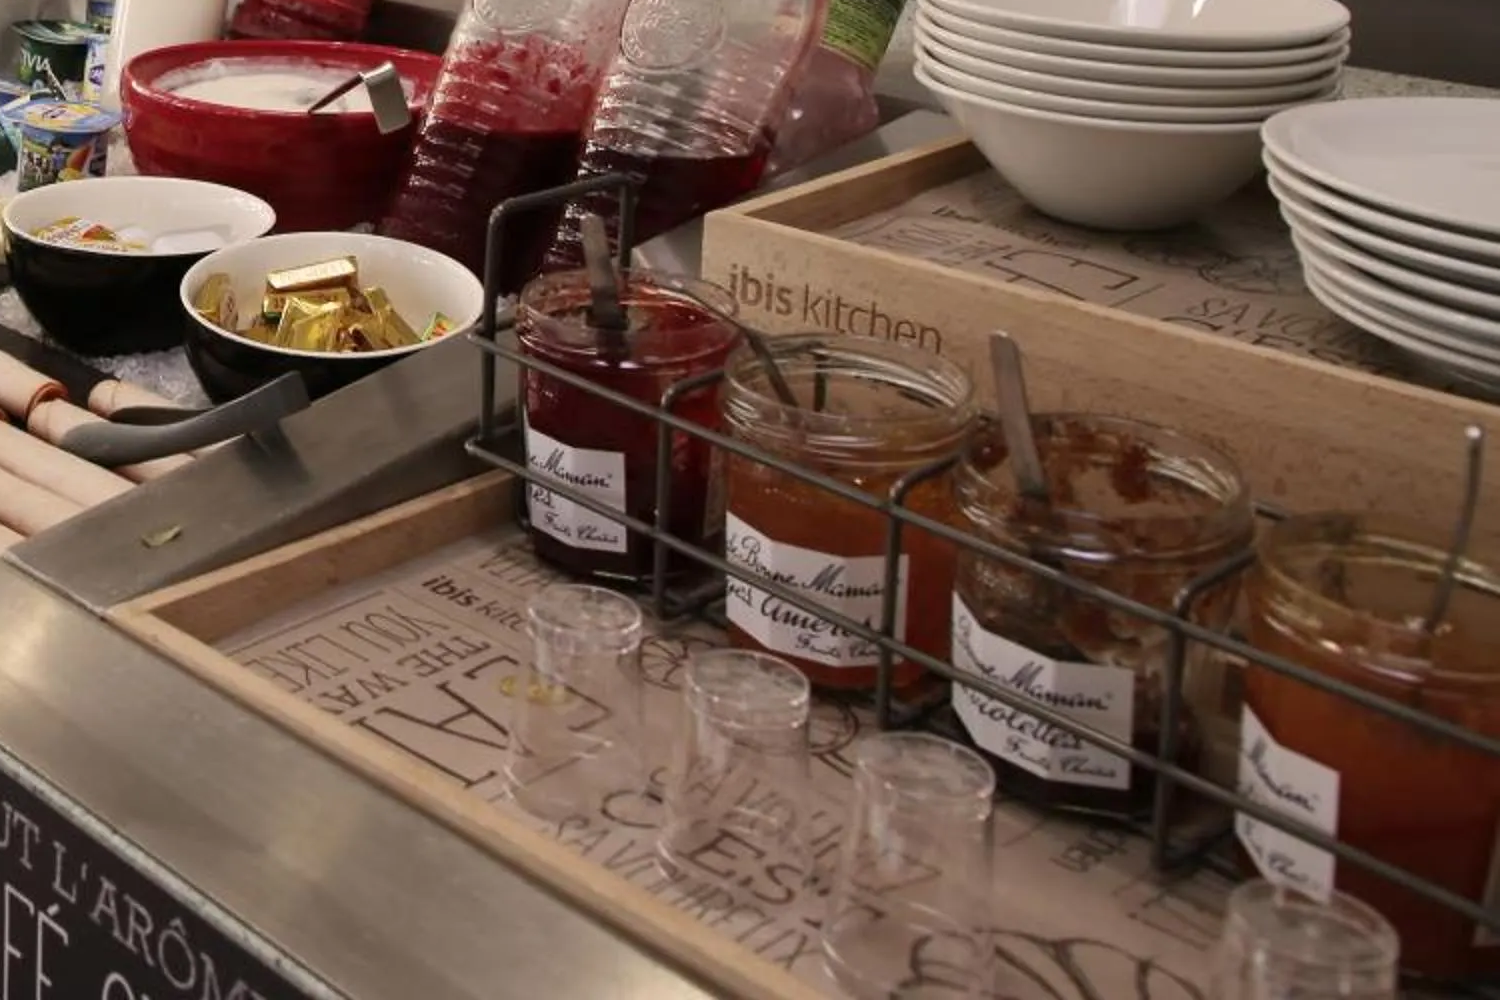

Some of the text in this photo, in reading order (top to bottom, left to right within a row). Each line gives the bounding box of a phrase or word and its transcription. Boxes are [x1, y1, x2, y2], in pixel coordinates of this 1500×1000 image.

[729, 263, 942, 355] ibis kitchen
[421, 575, 480, 607] ibis
[802, 563, 884, 598] Mama
[339, 604, 450, 653] YOU
[396, 635, 491, 678] THE
